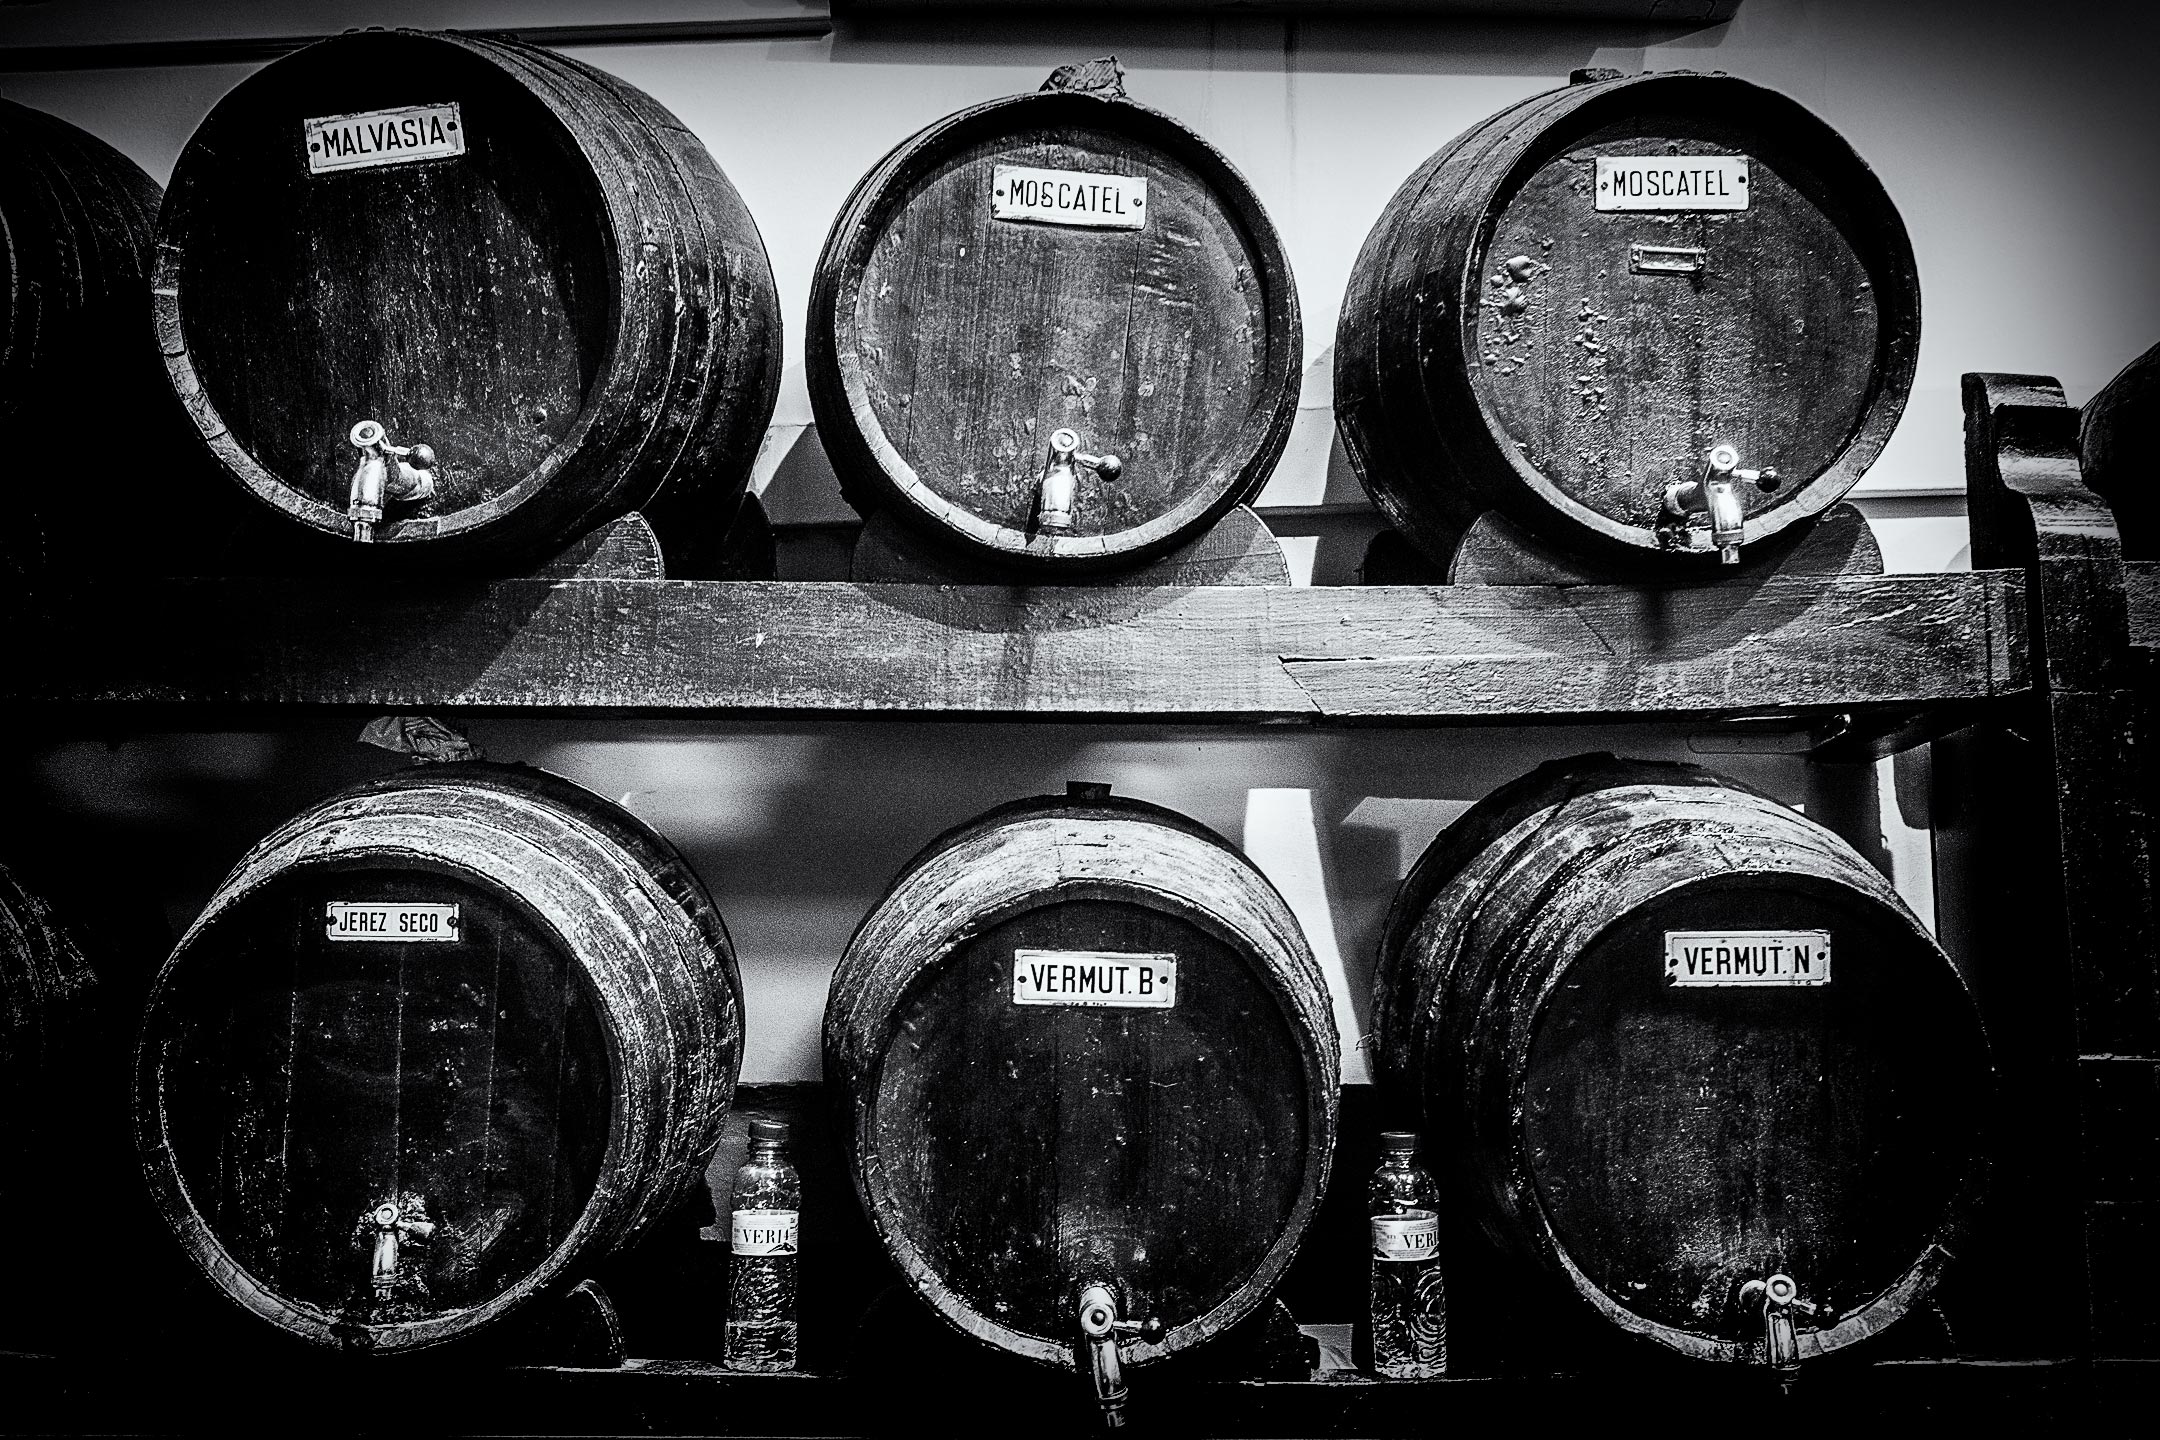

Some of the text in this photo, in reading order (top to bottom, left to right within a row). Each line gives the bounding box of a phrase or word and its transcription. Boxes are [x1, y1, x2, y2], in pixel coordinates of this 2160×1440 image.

[321, 115, 446, 158] MALVASIA
[1009, 178, 1126, 215] MOSCATEL
[1613, 169, 1730, 197] MOSCATEL
[339, 911, 438, 933] JEREZ SECO
[1794, 944, 1810, 974] N
[1138, 966, 1154, 995] B
